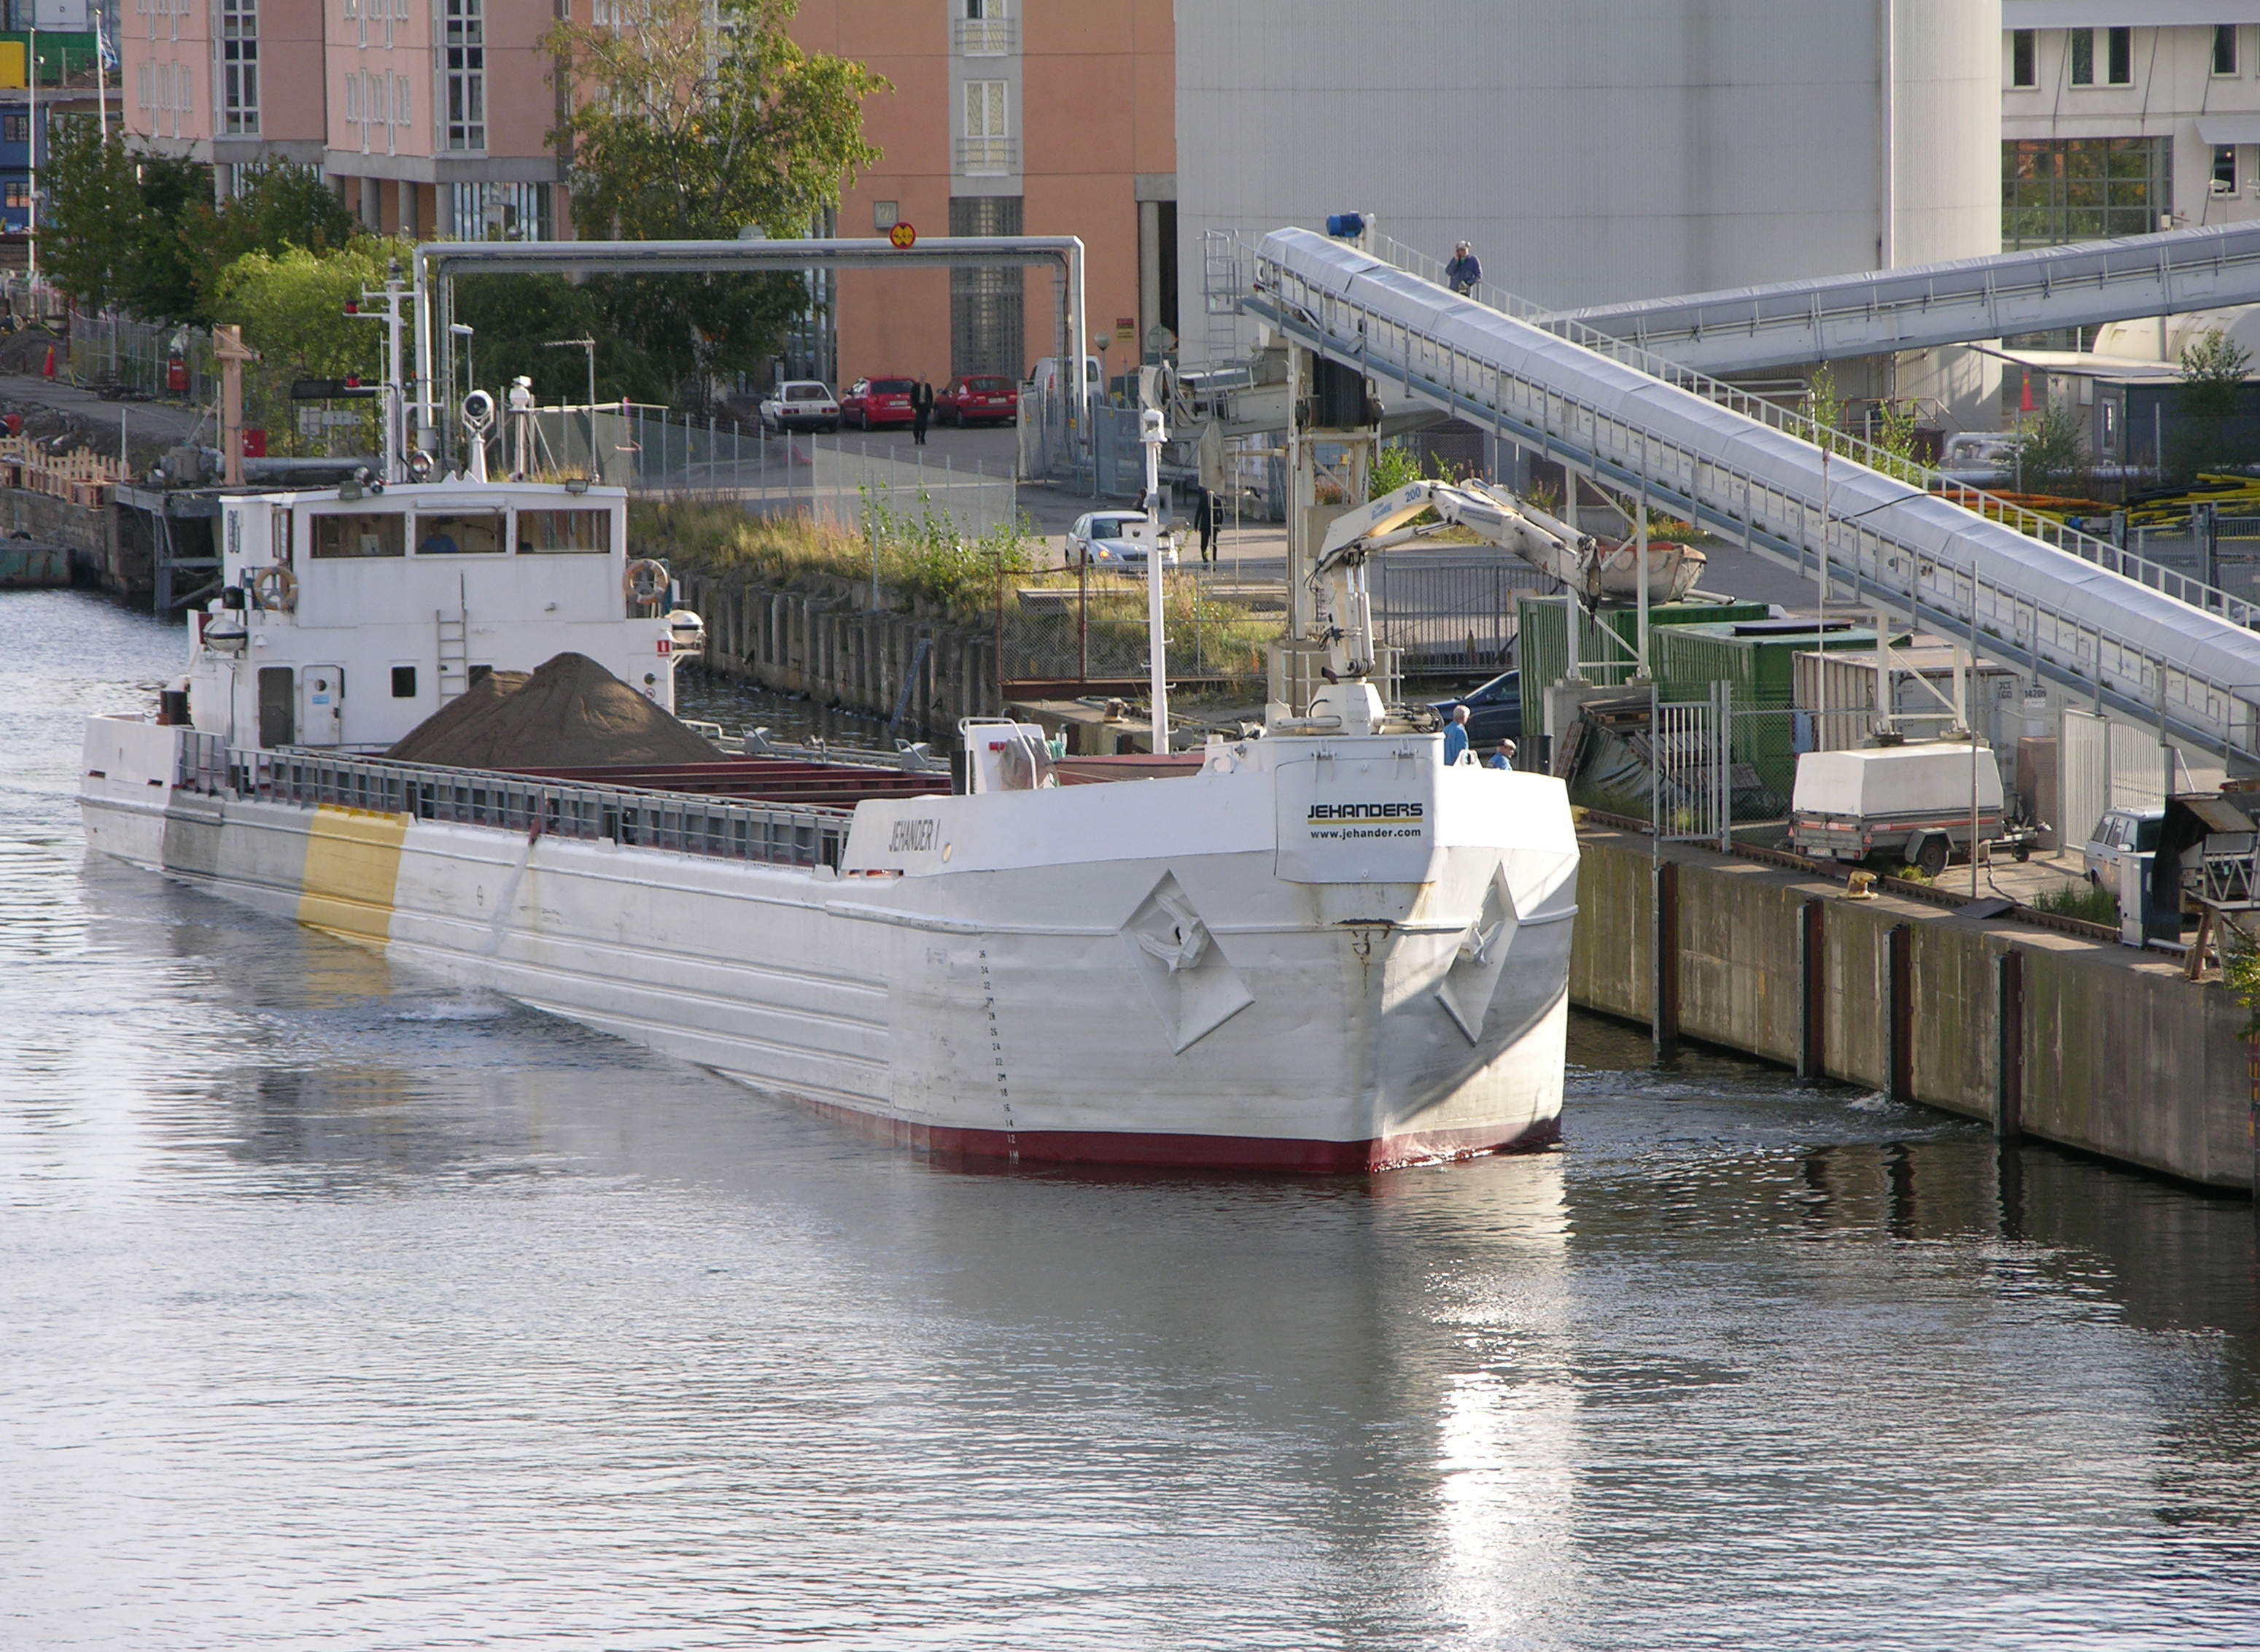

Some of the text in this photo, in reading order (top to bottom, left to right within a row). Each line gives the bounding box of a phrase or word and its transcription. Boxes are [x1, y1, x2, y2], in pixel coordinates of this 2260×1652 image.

[1405, 486, 1421, 503] 200
[1307, 803, 1423, 818] JEHANDERS
[889, 819, 933, 852] JEHANDER
[1310, 828, 1421, 840] www.jehander.com
[988, 1012, 995, 1020] 28
[990, 1027, 998, 1036] 26
[993, 1042, 1001, 1051] 24
[995, 1057, 1003, 1066] 22
[998, 1073, 1006, 1082] 2M
[1000, 1087, 1009, 1097] 18
[1003, 1103, 1011, 1112] 16
[1005, 1119, 1013, 1128] 14
[1007, 1134, 1016, 1144] 12
